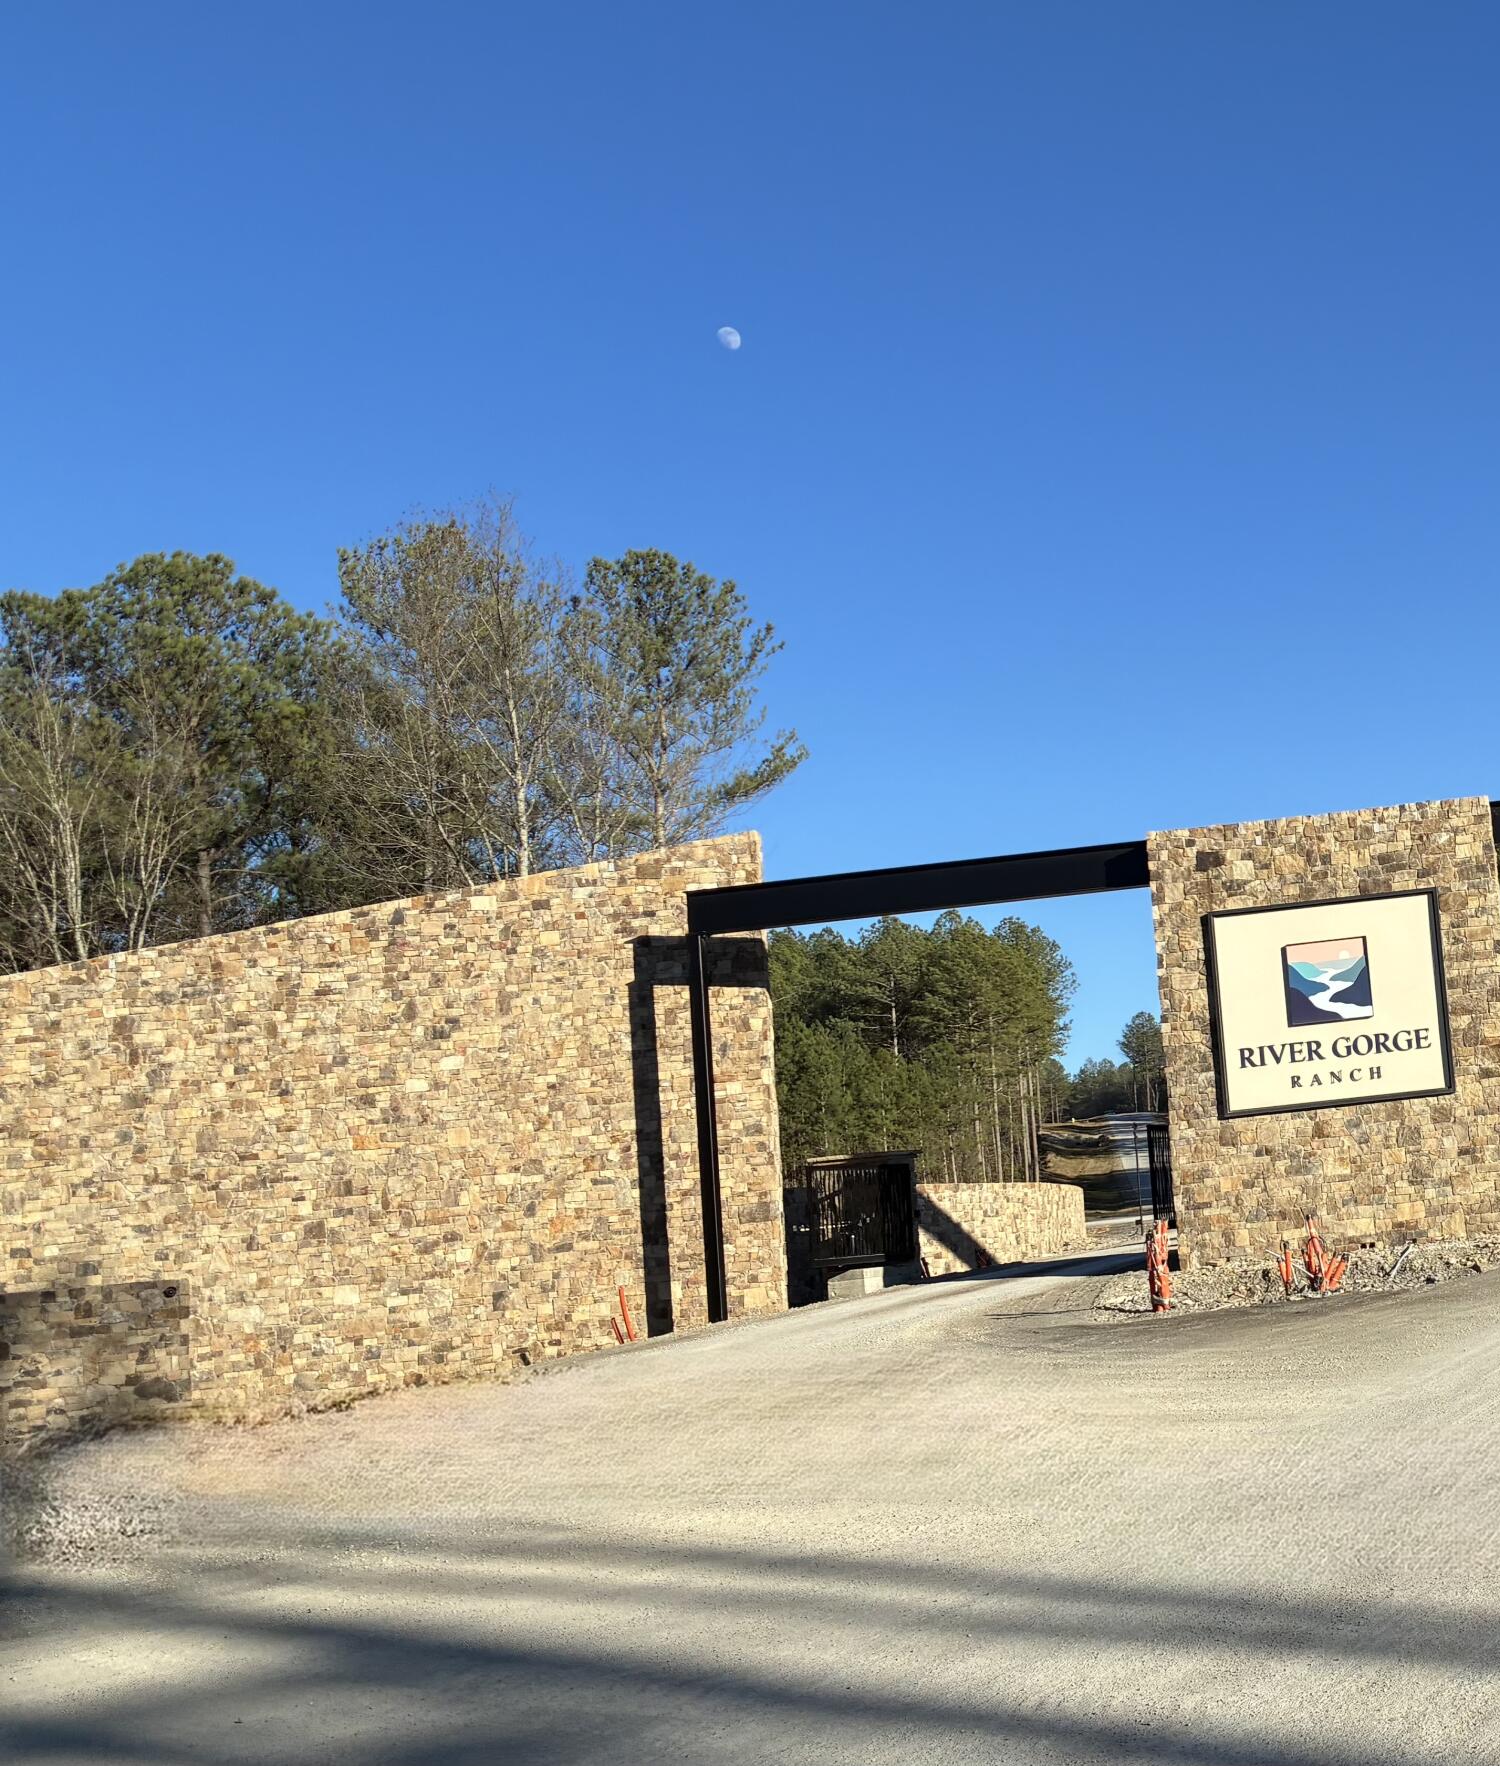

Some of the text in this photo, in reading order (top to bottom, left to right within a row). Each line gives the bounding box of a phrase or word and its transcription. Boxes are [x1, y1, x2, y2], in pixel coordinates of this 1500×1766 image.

[1238, 1028, 1431, 1069] RIVER GORGE
[1290, 1066, 1382, 1088] RANCH
